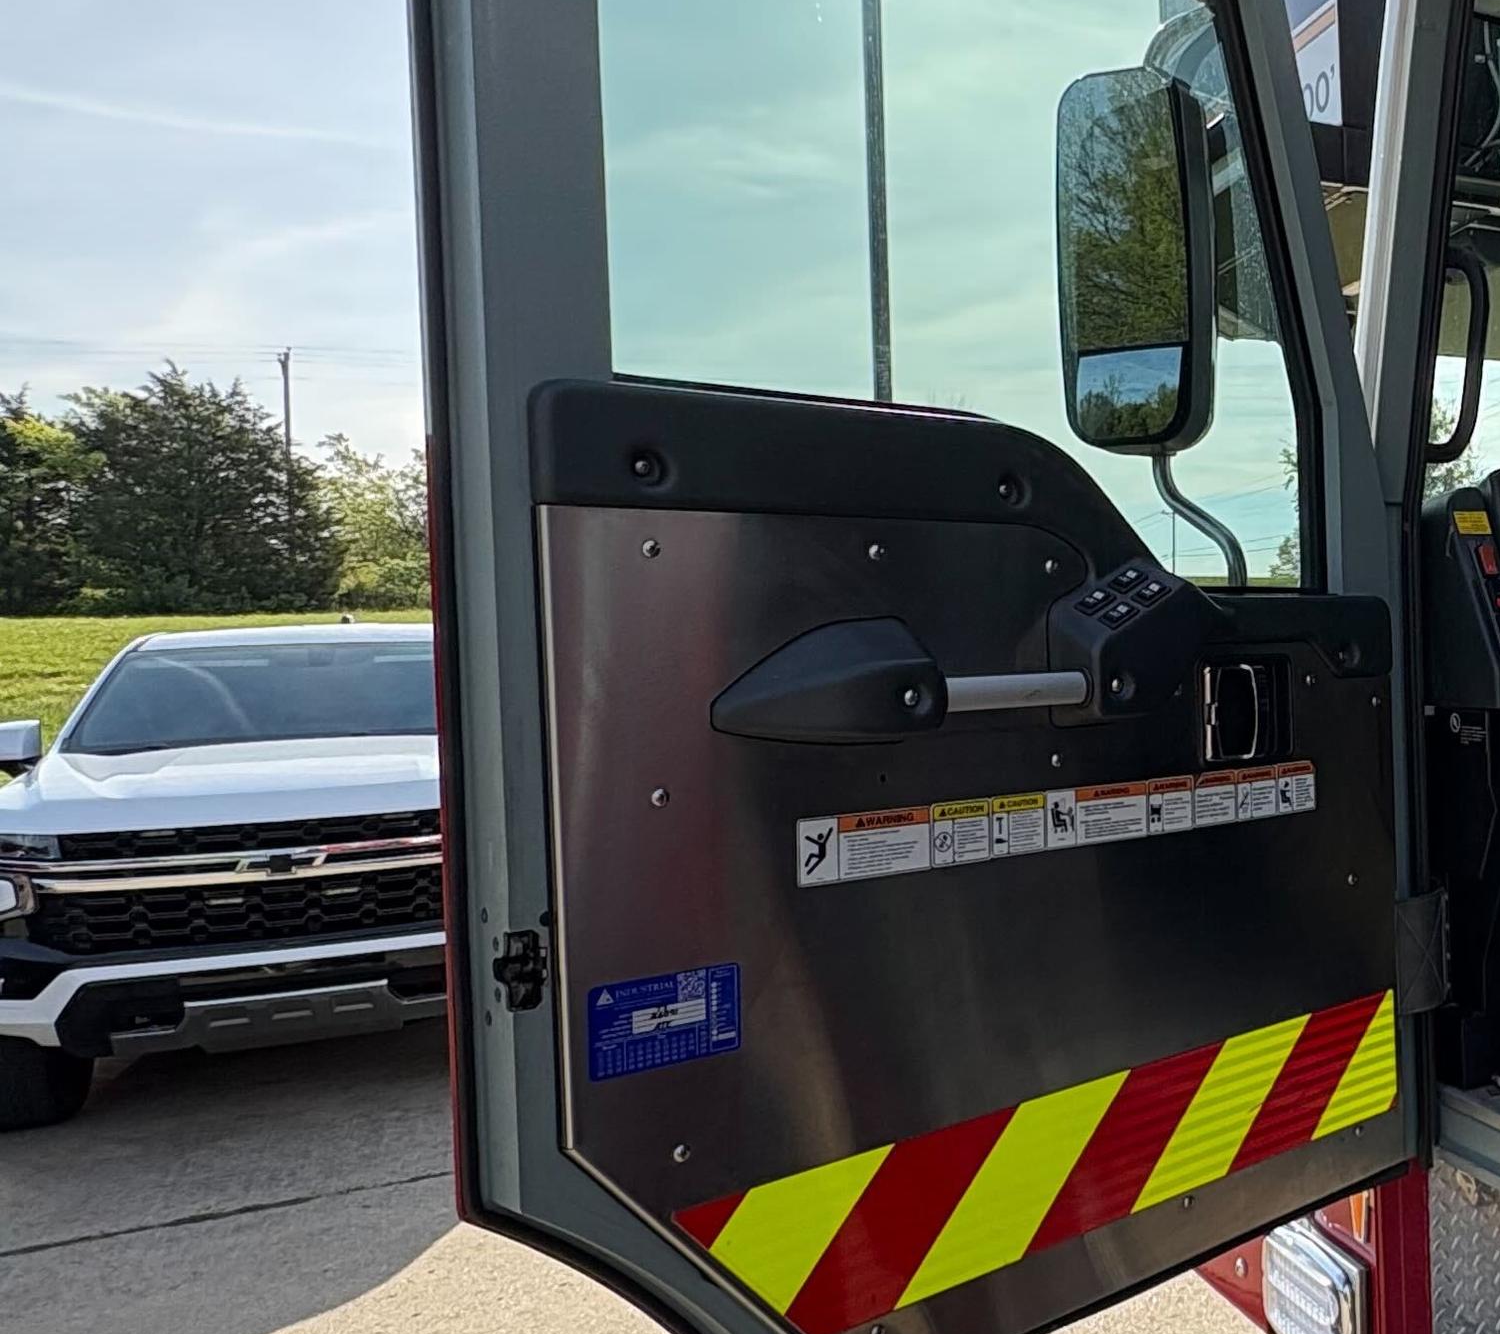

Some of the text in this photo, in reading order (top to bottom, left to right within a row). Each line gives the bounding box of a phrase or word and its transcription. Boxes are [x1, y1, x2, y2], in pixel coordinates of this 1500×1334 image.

[1006, 797, 1040, 808] CAUTION
[946, 804, 985, 816] CAUTION
[864, 812, 914, 828] WARNING
